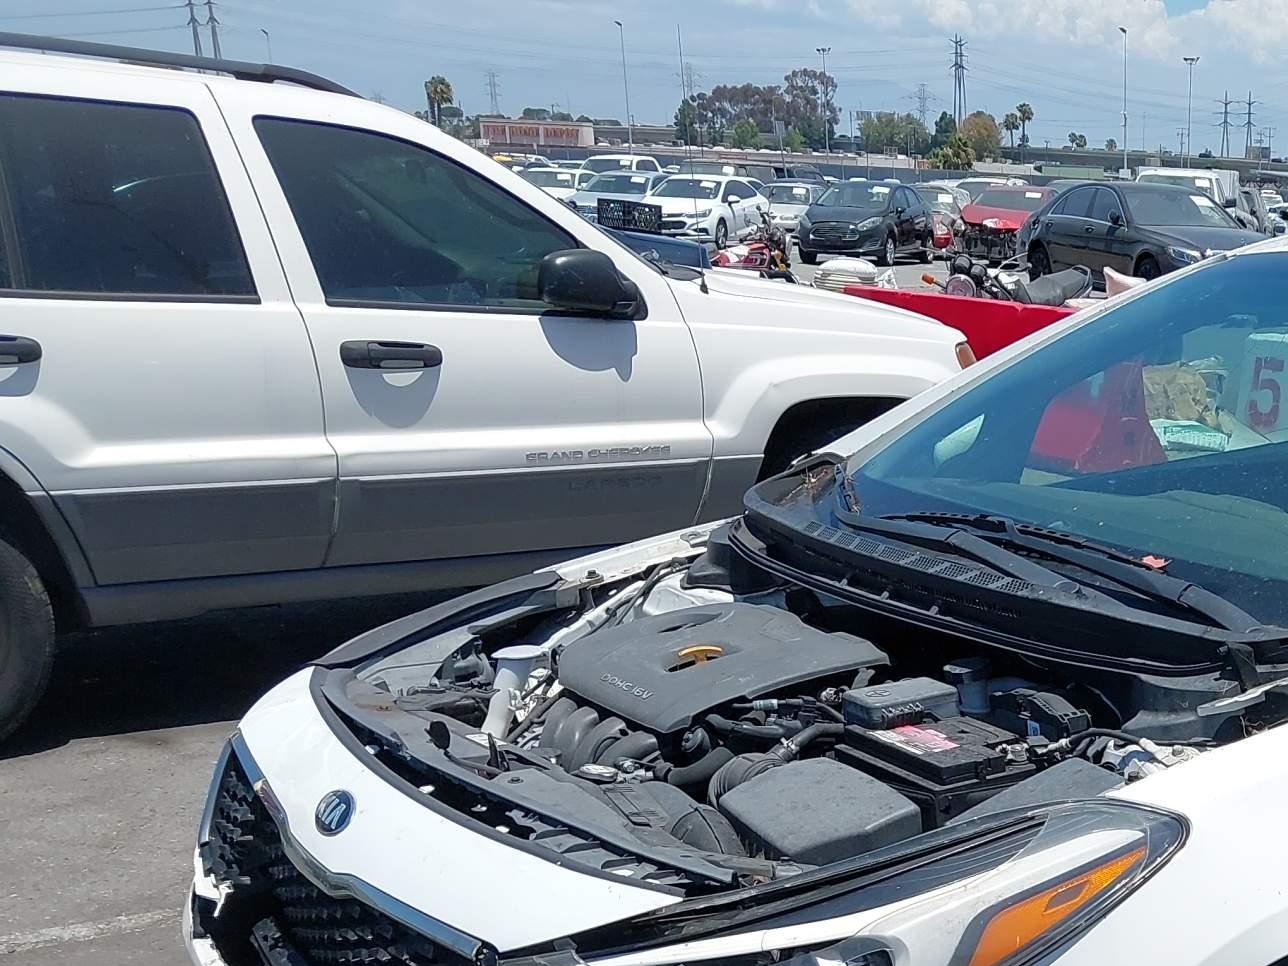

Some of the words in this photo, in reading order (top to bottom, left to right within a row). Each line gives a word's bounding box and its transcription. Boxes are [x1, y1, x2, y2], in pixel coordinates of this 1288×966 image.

[1247, 355, 1286, 427] 5
[525, 450, 583, 462] GRAND
[587, 445, 671, 459] CHEROKEE
[600, 673, 632, 691] DOHC
